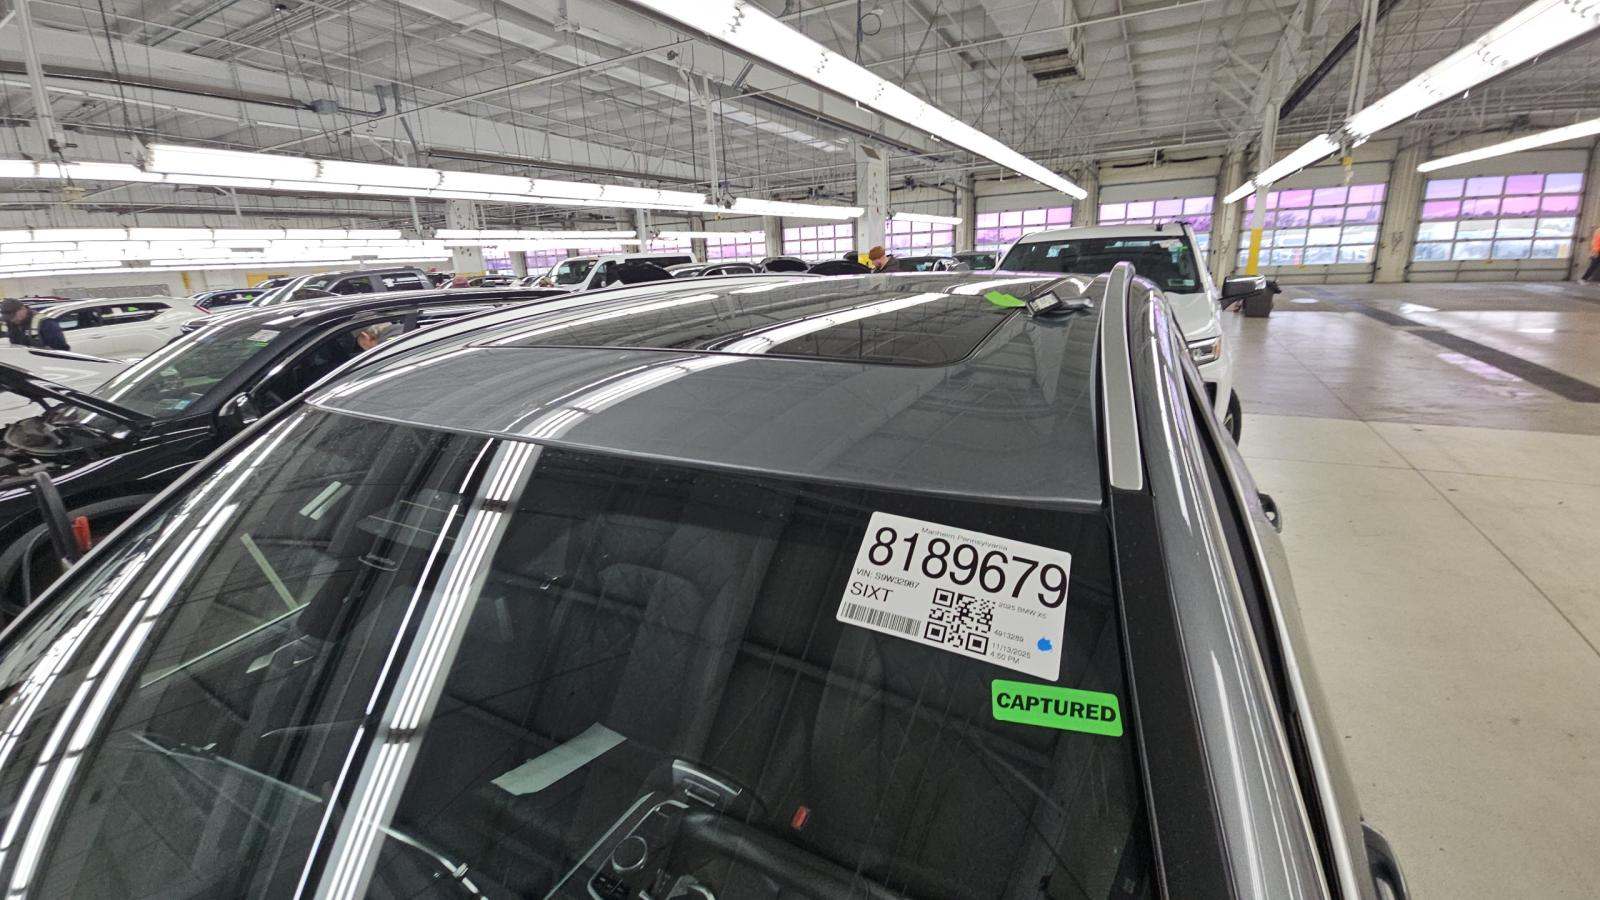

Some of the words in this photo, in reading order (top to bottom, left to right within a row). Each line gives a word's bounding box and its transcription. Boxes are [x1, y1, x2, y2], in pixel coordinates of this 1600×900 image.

[868, 526, 1068, 609] 8189679
[850, 581, 894, 602] SIXT
[996, 692, 1117, 722] CAPTURED
